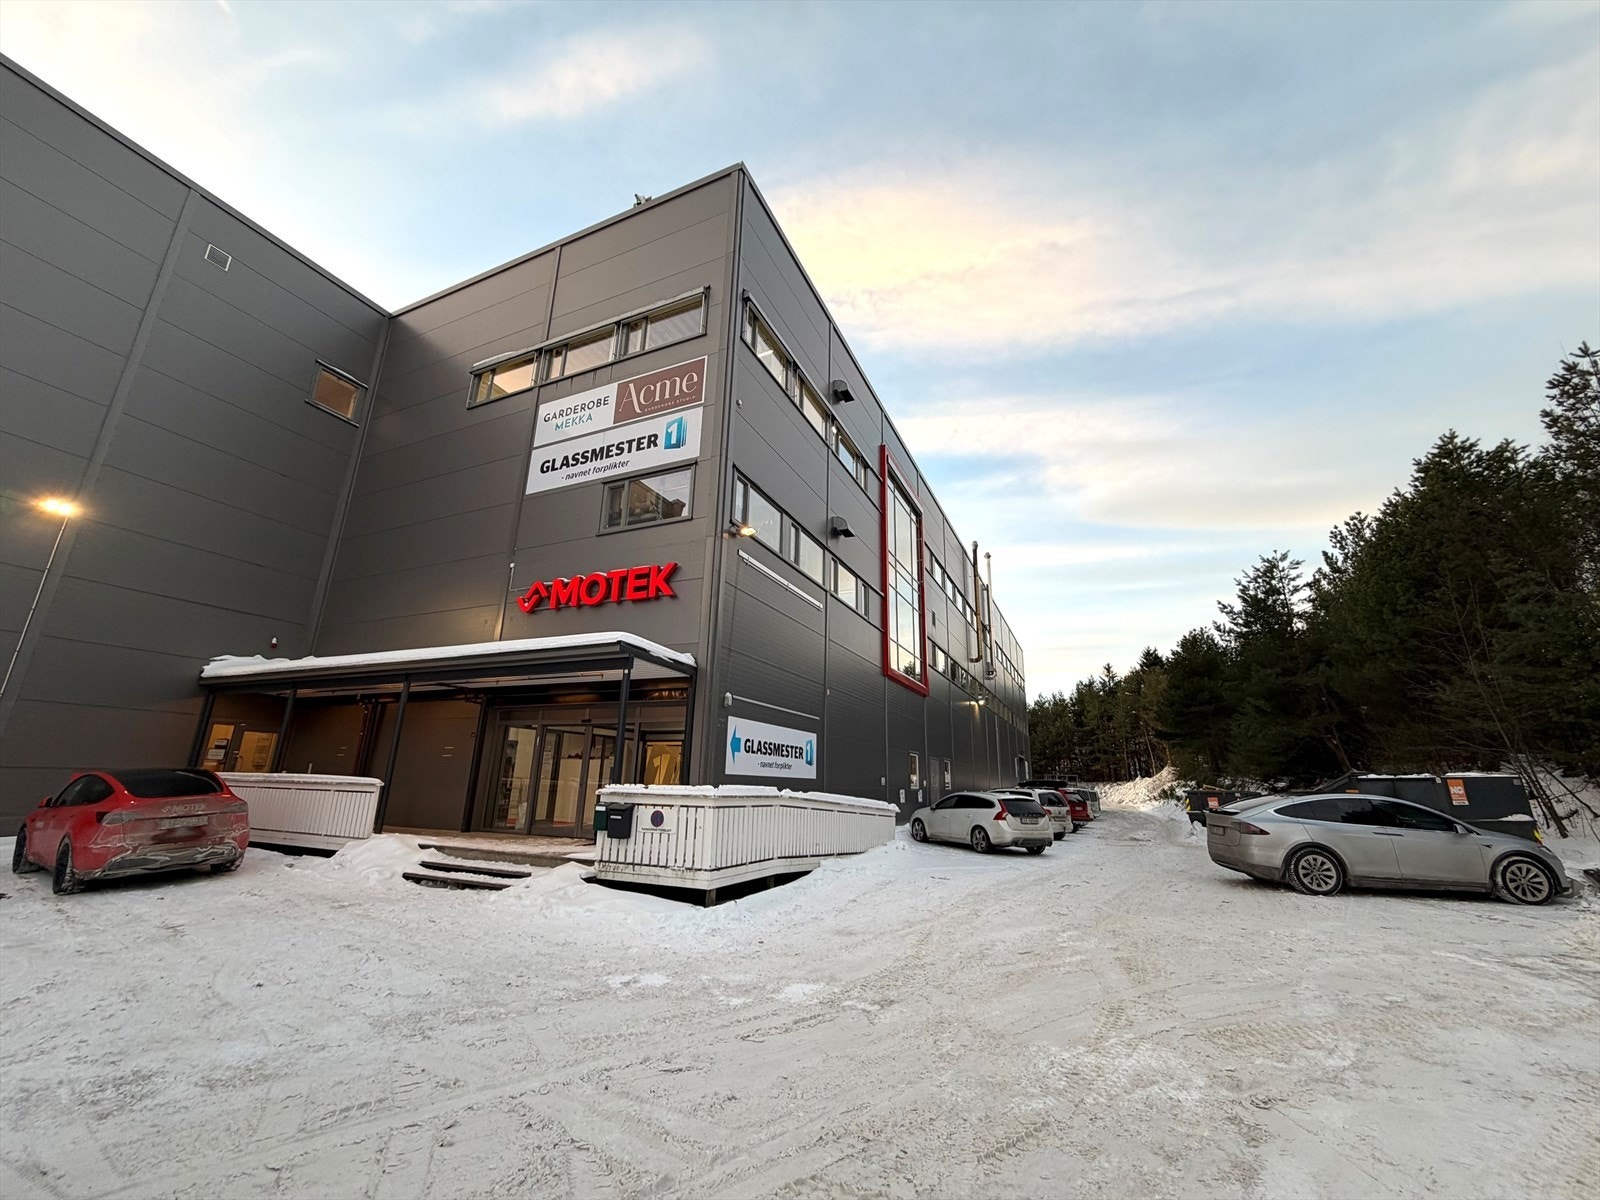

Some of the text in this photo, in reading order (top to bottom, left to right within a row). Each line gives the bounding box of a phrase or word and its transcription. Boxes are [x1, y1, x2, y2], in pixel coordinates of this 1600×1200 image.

[619, 372, 698, 413] Acme
[543, 395, 610, 423] GARDEROBE
[554, 413, 593, 431] MEKKA
[539, 432, 659, 475] GLASSMESTER
[565, 468, 591, 481] navnet
[592, 459, 630, 477] forplikter
[549, 561, 678, 609] MOTEK
[744, 738, 804, 760] GLASSMESTER
[774, 761, 793, 770] forplikter
